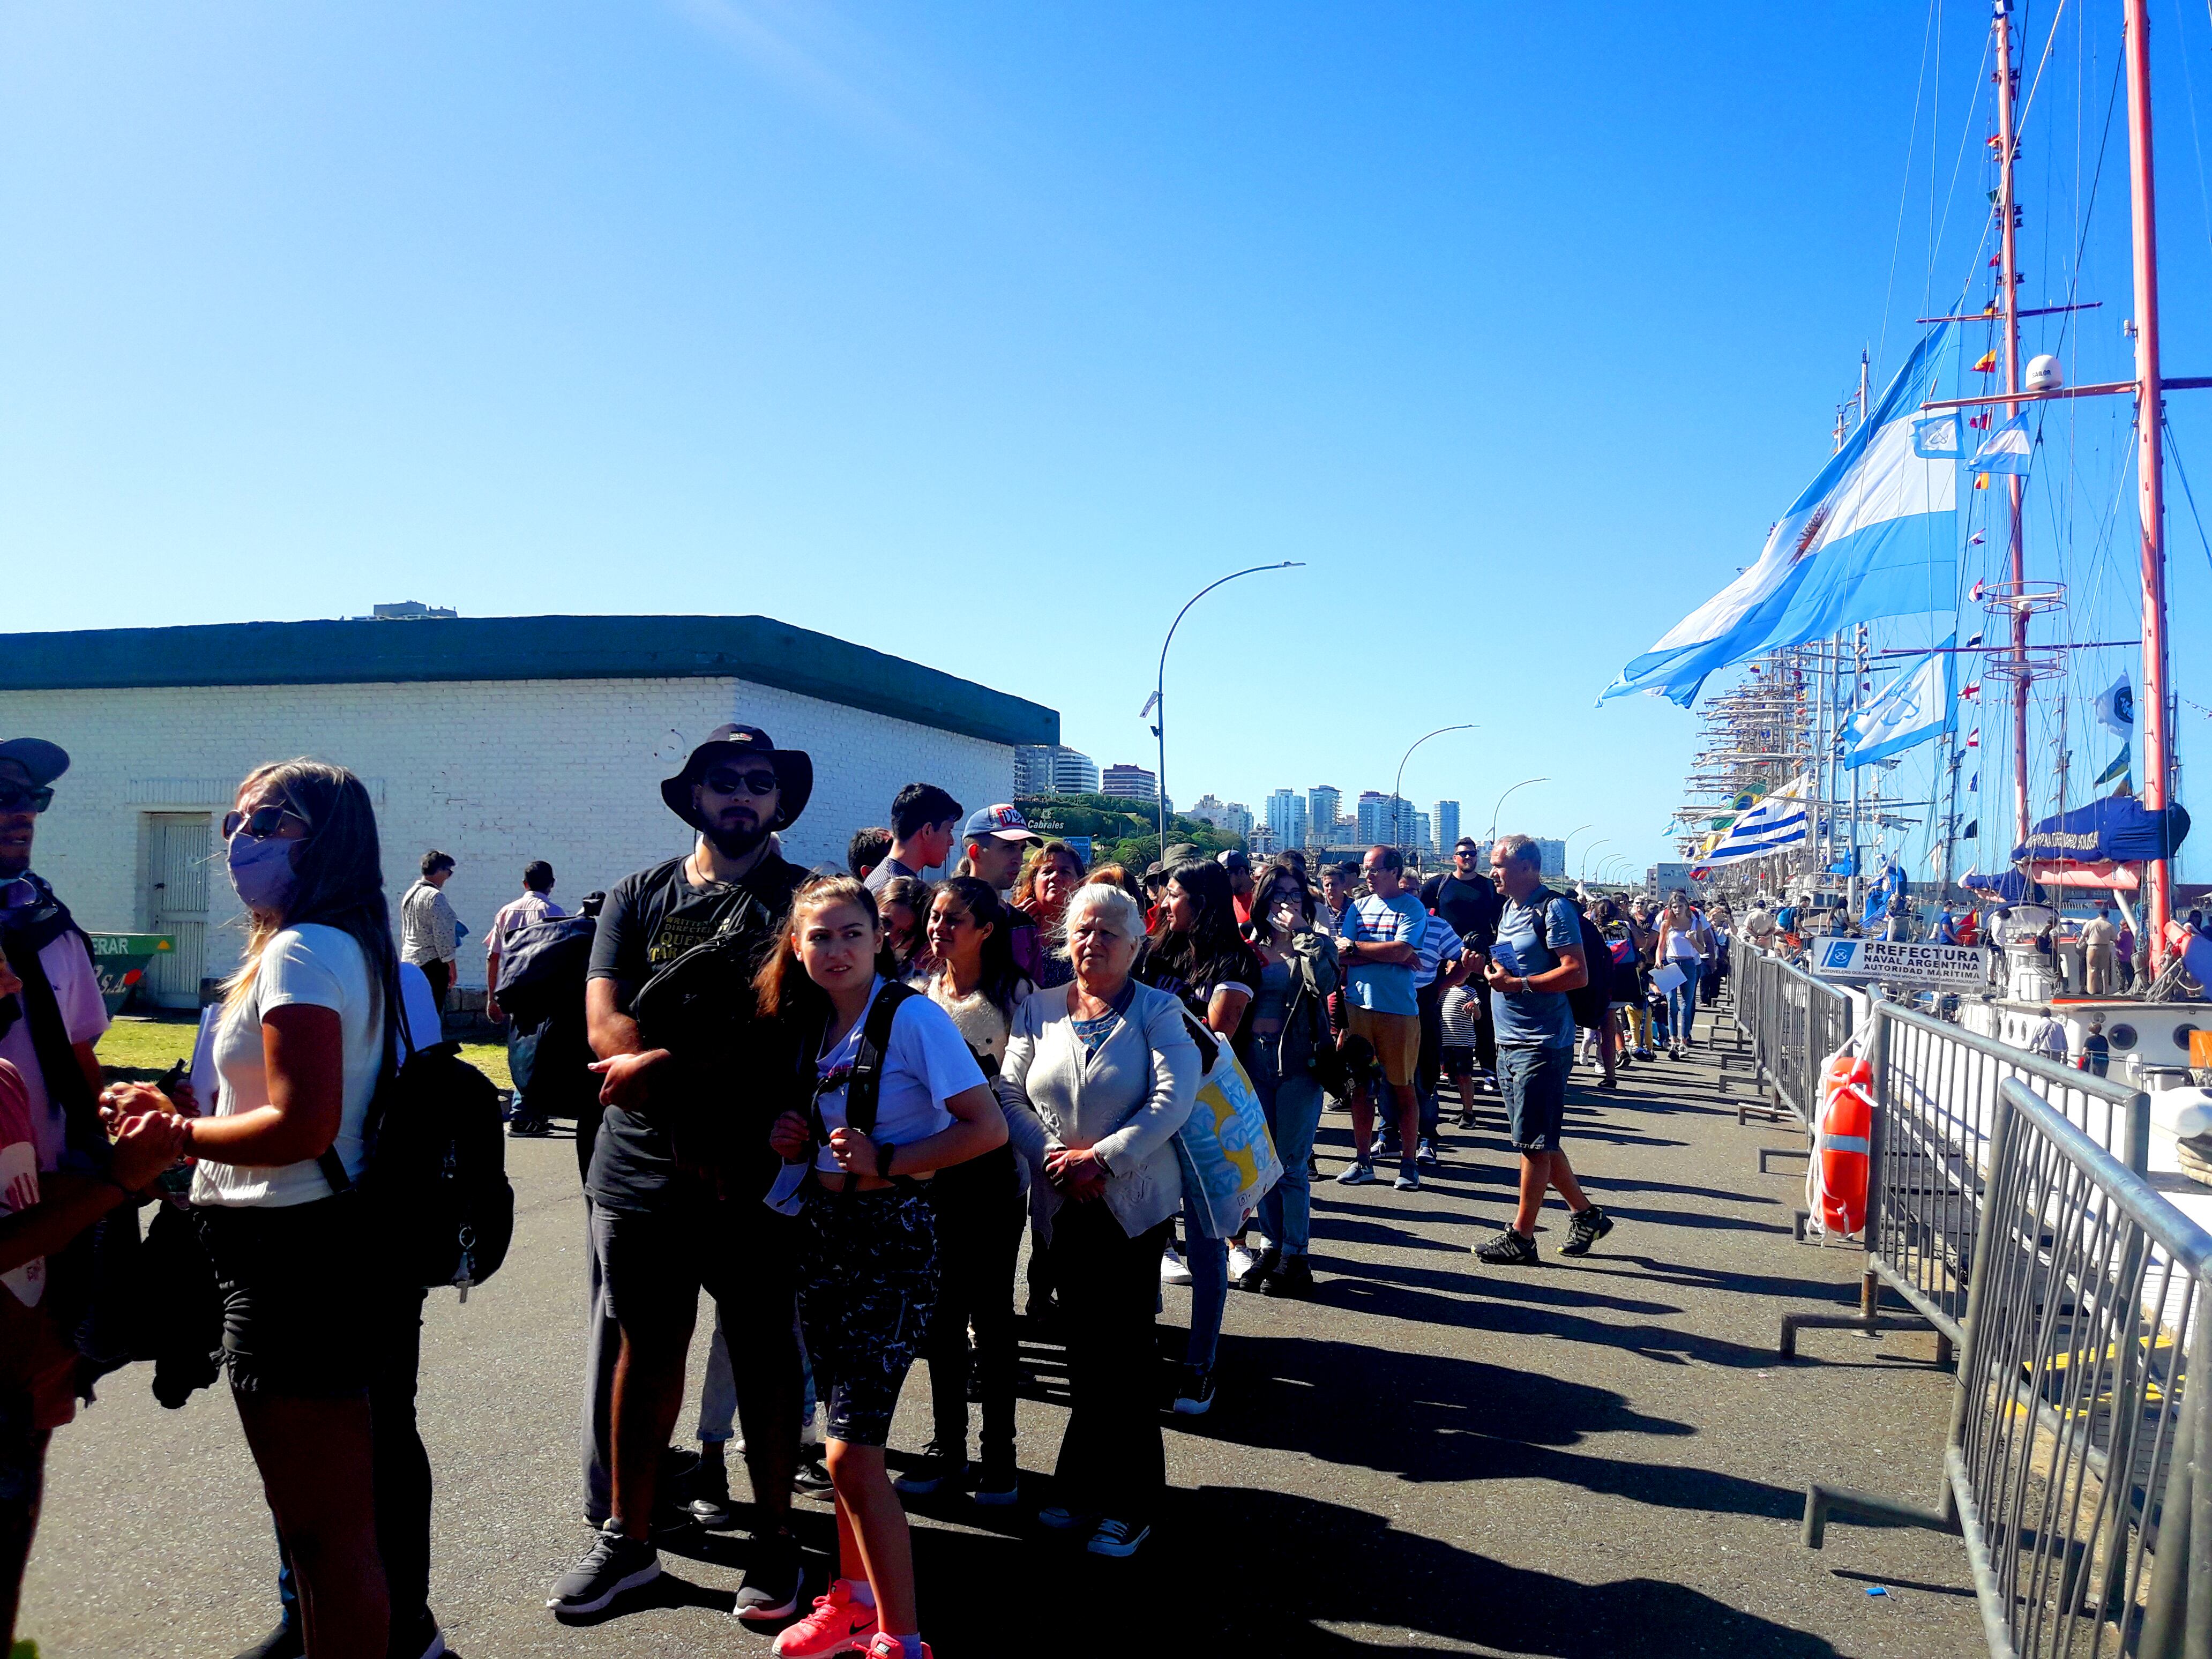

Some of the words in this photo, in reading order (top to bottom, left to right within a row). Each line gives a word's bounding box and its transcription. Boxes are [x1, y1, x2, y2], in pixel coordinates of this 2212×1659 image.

[2032, 370, 2051, 378] SAILOR
[1027, 819, 1065, 829] Cabrales
[1865, 943, 1980, 962] PREFECTURA
[1864, 954, 1902, 965] NAVAL
[1907, 959, 1978, 970] ARGENTINA
[1864, 963, 1923, 975] AUTORIDAD
[1927, 969, 1980, 979] MARÍTIMA
